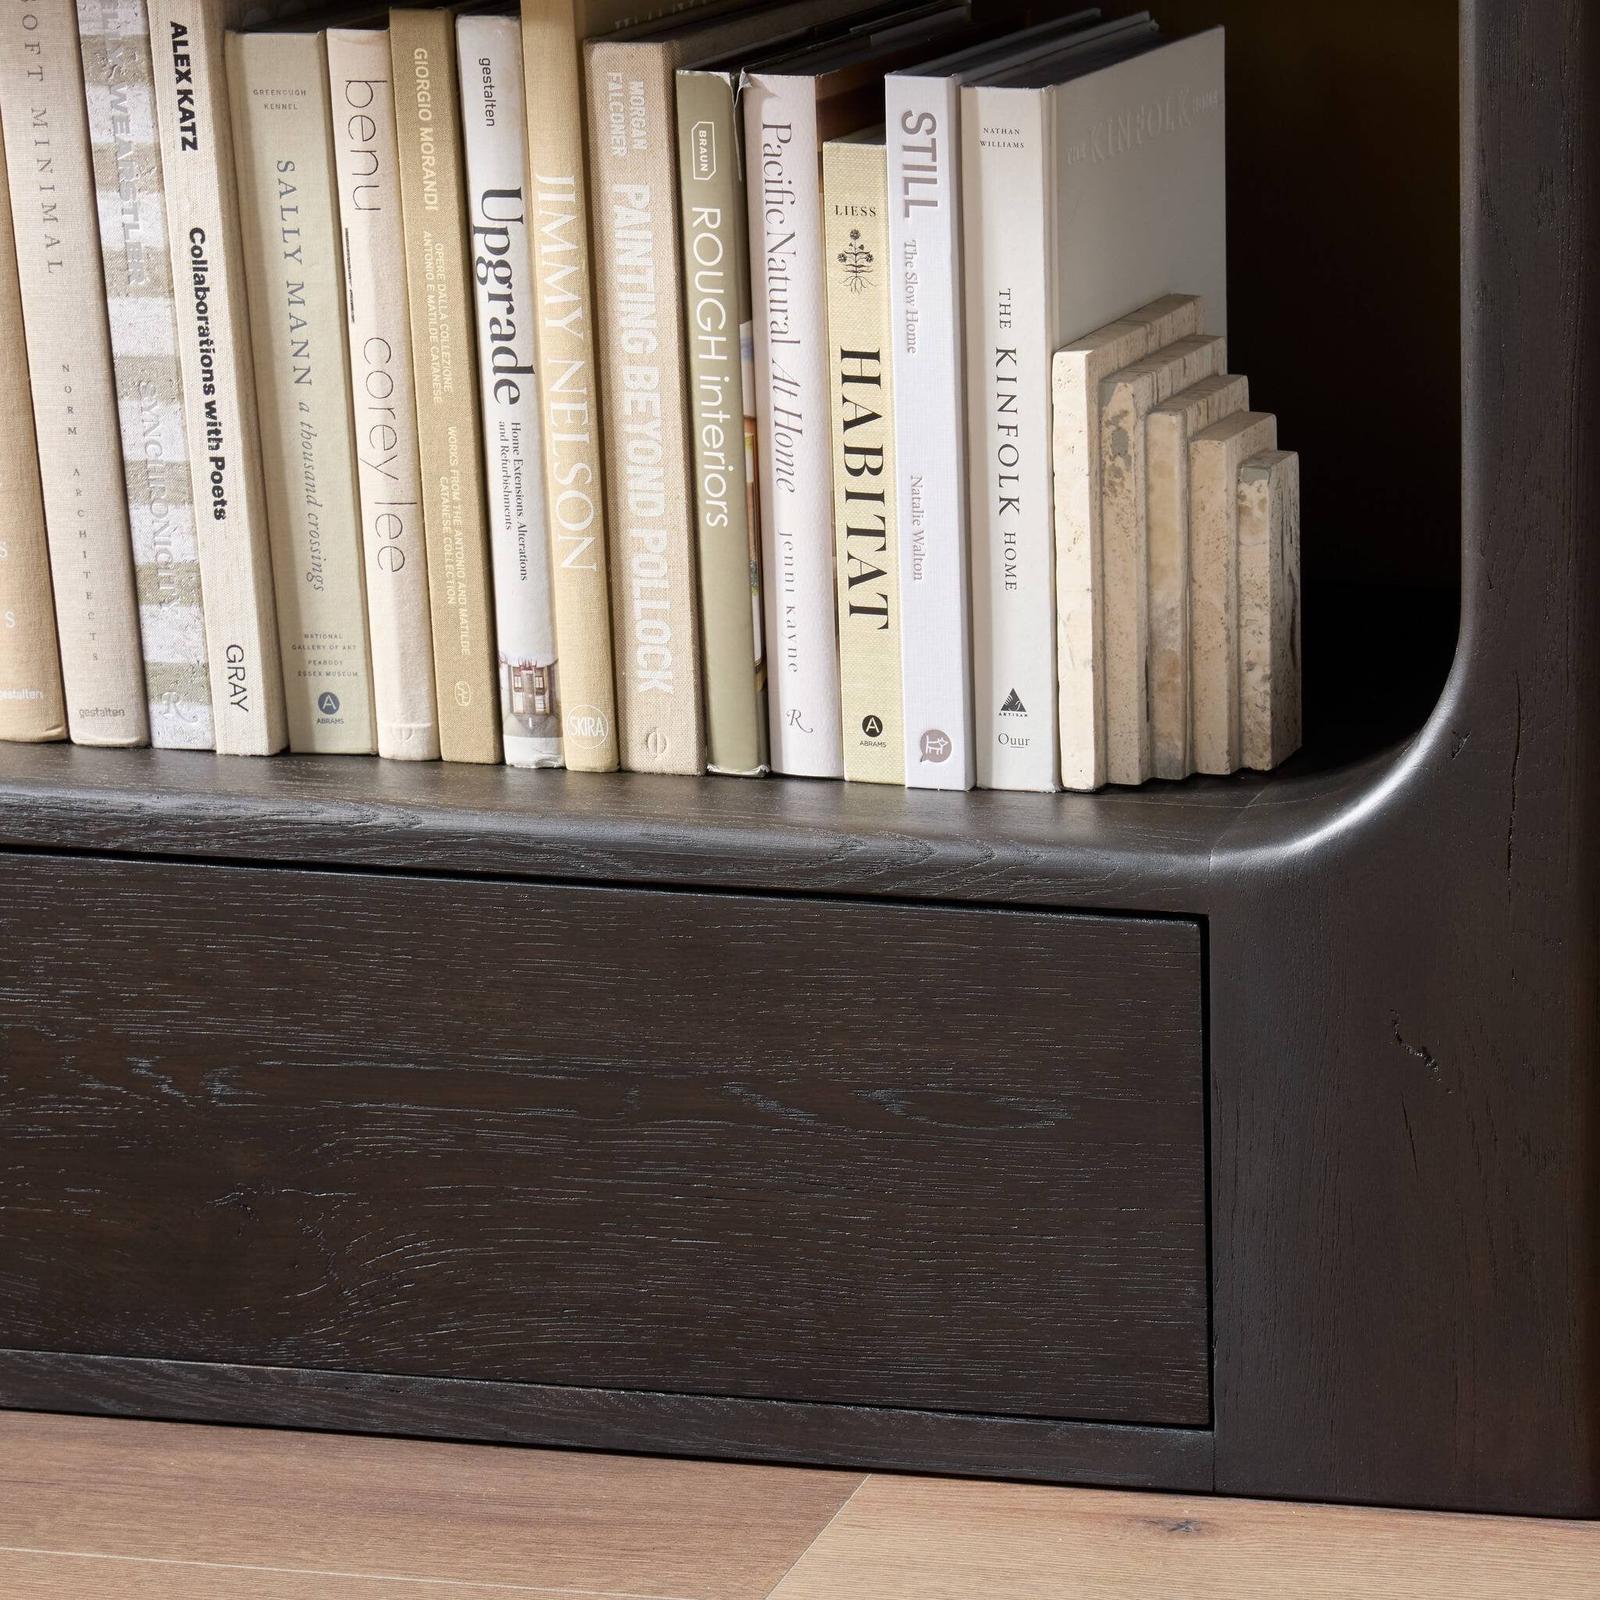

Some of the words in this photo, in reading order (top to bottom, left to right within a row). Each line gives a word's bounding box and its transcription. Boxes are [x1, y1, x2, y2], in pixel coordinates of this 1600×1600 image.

[21, 0, 44, 82] OFT
[170, 21, 192, 84] ALEX
[413, 47, 433, 123] GIORGIO
[478, 57, 497, 128] gestalten
[605, 71, 628, 157] FALCONER
[628, 79, 649, 152] MORGAN
[176, 89, 198, 152] KATZ
[345, 79, 388, 212] benu
[697, 129, 709, 173] BRAUN
[978, 139, 1026, 149] WILLIAMS
[982, 126, 1021, 136] NATHAN
[31, 107, 64, 275] MINIMAL
[109, 84, 146, 287] WEARSTLER
[418, 126, 439, 212] MORANDI
[762, 122, 797, 225] Pacific
[901, 109, 939, 220] STILL
[276, 159, 304, 265] SALLY
[834, 204, 877, 218] LIESS
[422, 230, 436, 281] ANTONIO
[434, 243, 448, 282] OPERE
[534, 174, 585, 342] JIMMY
[613, 182, 660, 355] PAINTING
[691, 205, 728, 361] ROUGH
[903, 239, 918, 268] The
[188, 227, 217, 398] Collaborations
[426, 283, 435, 292] E
[426, 294, 439, 344] MATILDE
[437, 283, 449, 321] DALLA
[473, 186, 536, 406] Upgrade
[766, 231, 801, 346] Natural
[904, 271, 919, 306] Slow
[997, 288, 1012, 330] THE
[286, 280, 313, 387] MANN
[438, 323, 453, 394] COLLEZIONE
[905, 309, 920, 355] Home
[298, 402, 310, 413] a
[429, 345, 443, 405] CATANESE
[771, 357, 803, 400] At
[203, 399, 224, 453] with
[359, 337, 400, 481] corey
[499, 420, 508, 441] and
[623, 363, 667, 519] BEYOND
[994, 346, 1022, 517] KINFOLK
[299, 421, 324, 508] thousand
[447, 425, 459, 466] WORKS
[547, 358, 597, 573] NELSON
[698, 376, 735, 528] interiors
[773, 405, 804, 494] Home
[209, 455, 227, 522] Poets
[439, 475, 451, 534] CATANESE
[450, 468, 461, 501] FROM
[452, 504, 463, 525] THE
[500, 441, 513, 531] Refurbishments
[510, 421, 522, 456] Home
[516, 520, 528, 582] Alterations
[839, 345, 890, 631] HABITAT
[909, 475, 924, 526] Natalie
[305, 512, 326, 592] crossings
[374, 500, 418, 574] lee
[443, 536, 457, 605] COLLECTION
[454, 528, 466, 579] ANTONIO
[912, 527, 928, 582] Walton
[1003, 531, 1018, 591] HOME
[457, 581, 468, 606] AND
[628, 526, 676, 696] POLLOCK
[459, 607, 471, 656] MATILDE
[78, 704, 126, 719] gestalten
[225, 643, 251, 714] GRAY
[316, 717, 345, 726] ABRAMS
[569, 717, 606, 738] SKIRA
[859, 740, 887, 749] ABRAMS
[997, 732, 1031, 747] Ouur
